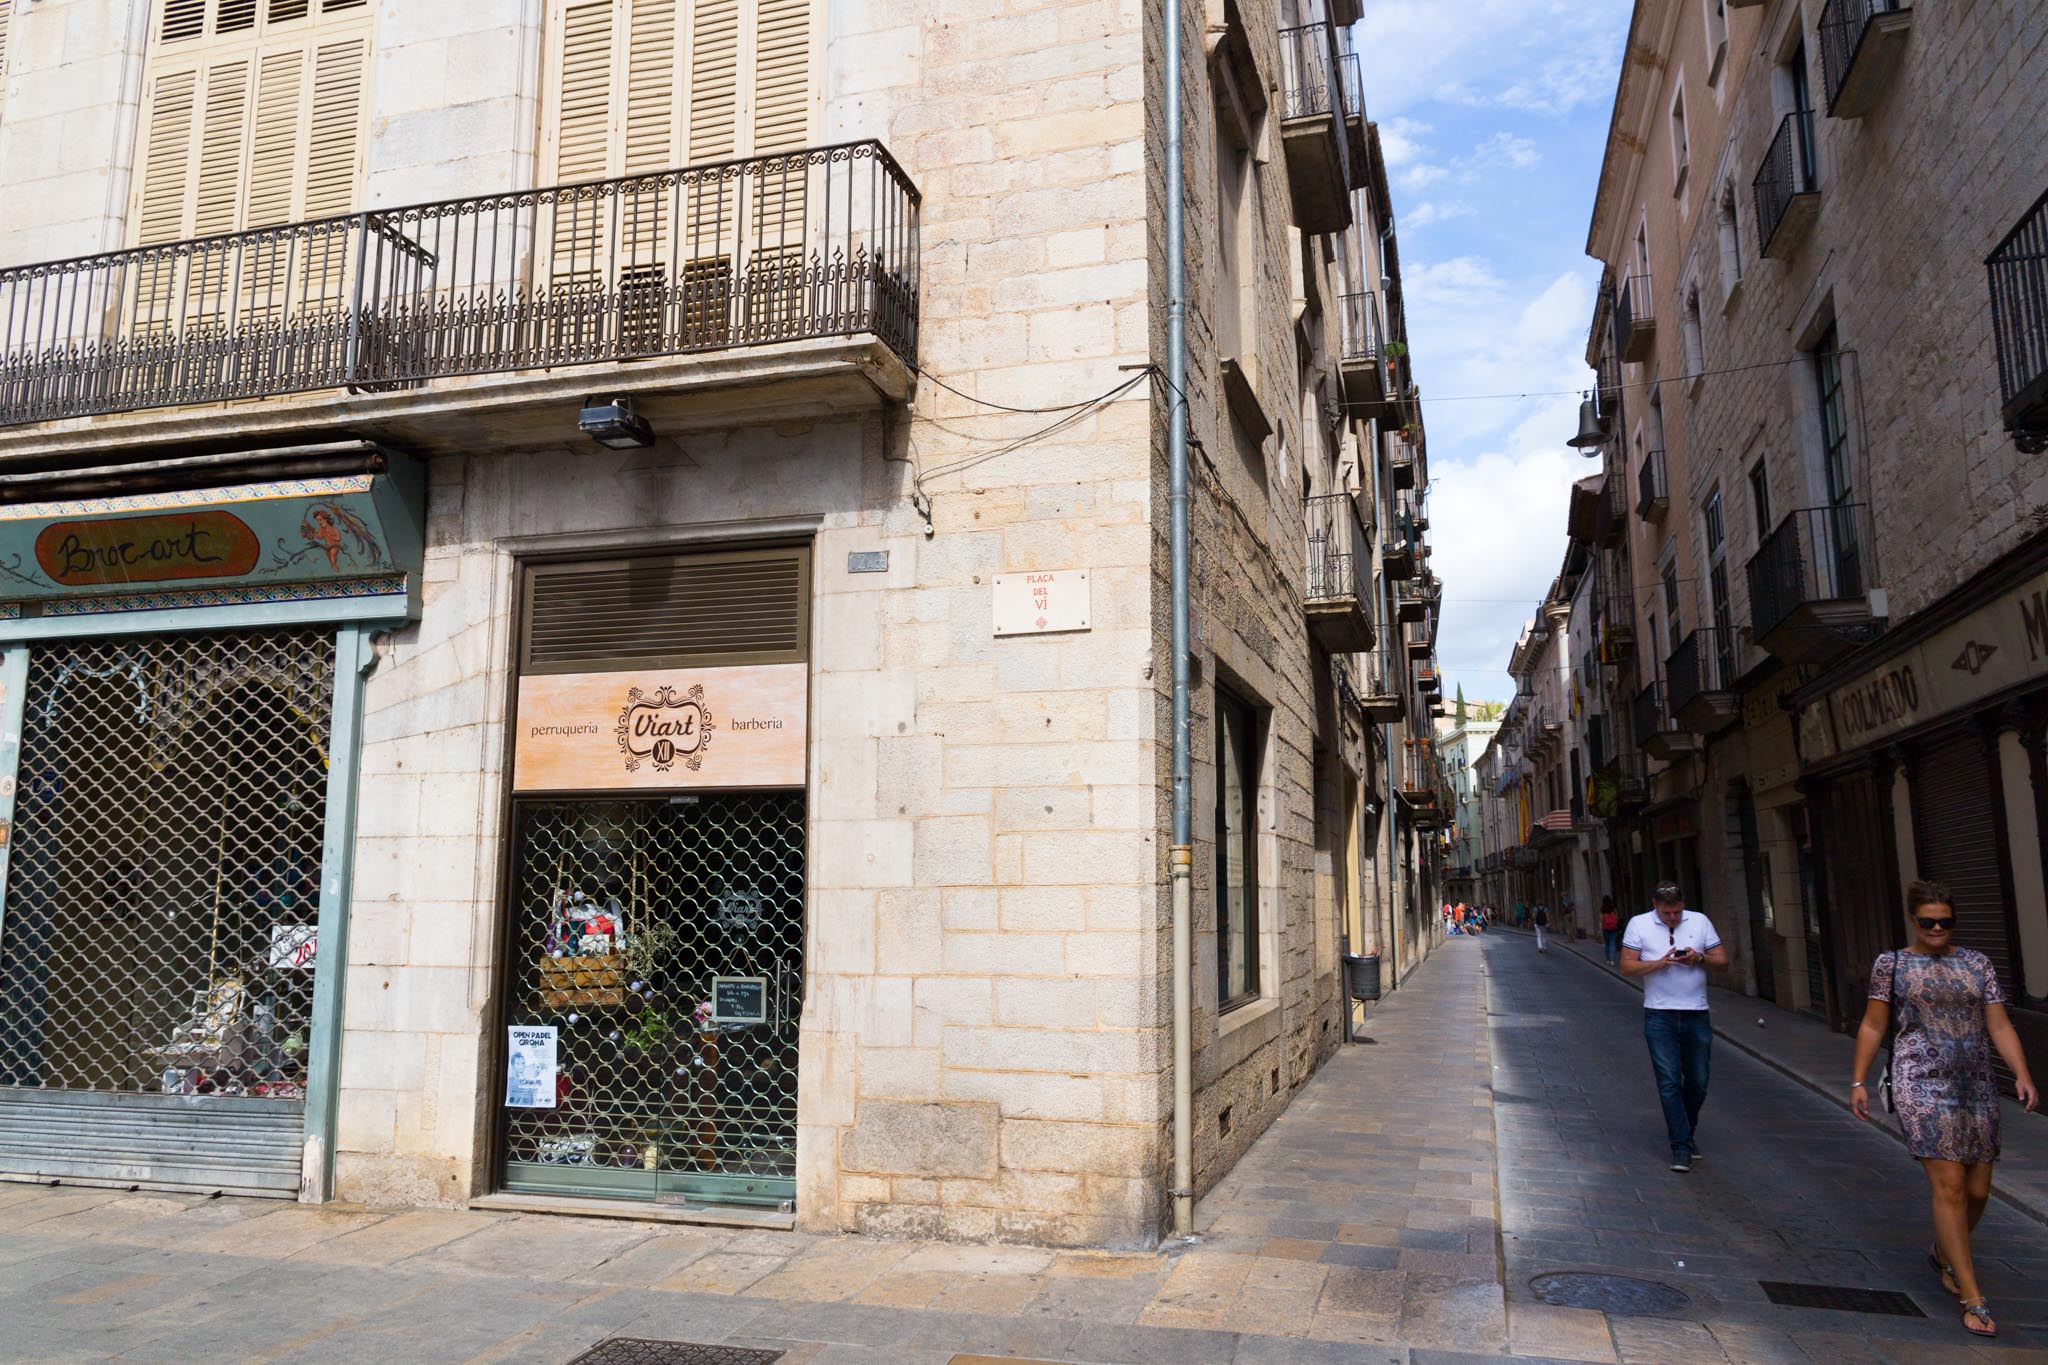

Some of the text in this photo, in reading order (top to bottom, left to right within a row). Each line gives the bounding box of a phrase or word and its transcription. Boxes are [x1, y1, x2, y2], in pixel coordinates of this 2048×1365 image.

[58, 522, 224, 577] Broc-art
[1026, 574, 1055, 584] PLAÇA
[1033, 587, 1048, 596] DEL
[1842, 665, 1919, 735] COLMADO
[531, 721, 599, 738] perruqueria
[635, 714, 693, 737] Viart
[732, 717, 783, 731] barberia
